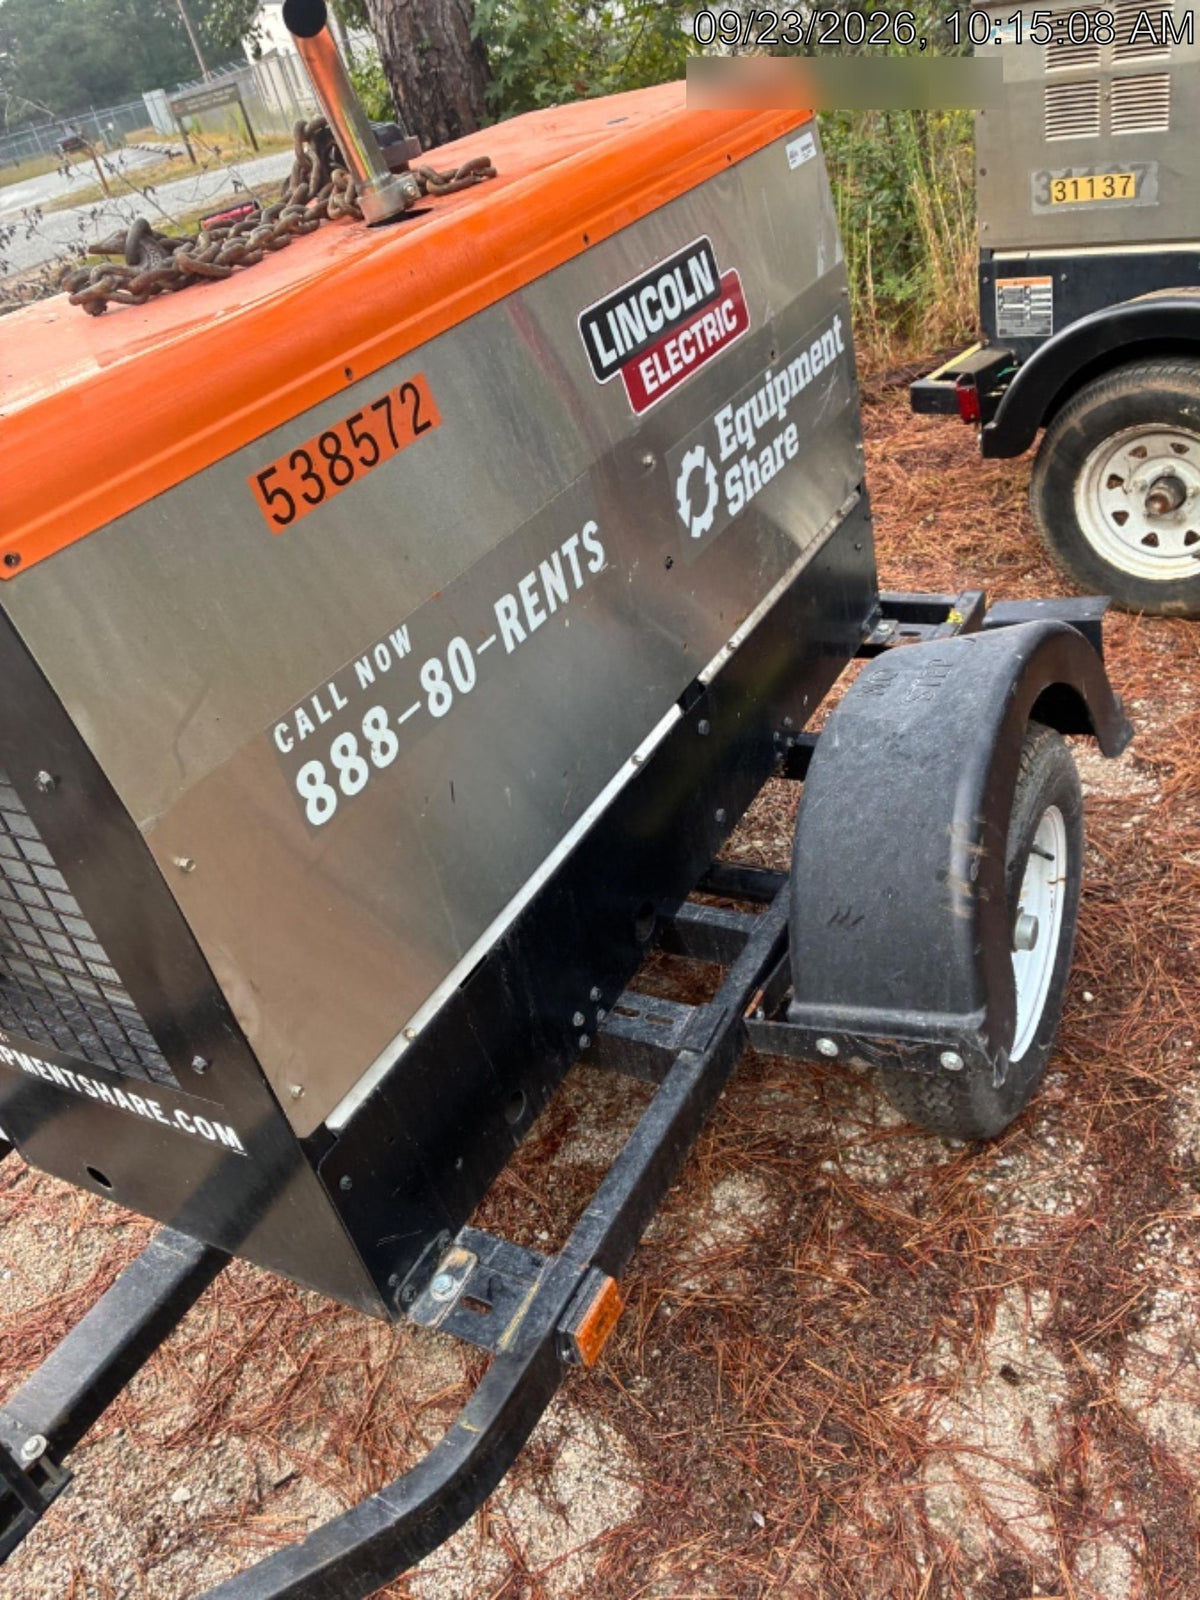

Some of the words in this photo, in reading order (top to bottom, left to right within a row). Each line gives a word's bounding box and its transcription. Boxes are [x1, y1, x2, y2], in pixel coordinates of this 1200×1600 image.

[1053, 174, 1132, 203] 31137
[589, 250, 716, 369] LINCOLN
[638, 297, 738, 396] ELECTRIC
[713, 313, 845, 462] Equipment
[256, 380, 433, 526] 538572
[722, 421, 799, 517] Share
[273, 680, 348, 754] CALL
[353, 623, 412, 690] NOW
[296, 519, 607, 826] 888-80-RENTS
